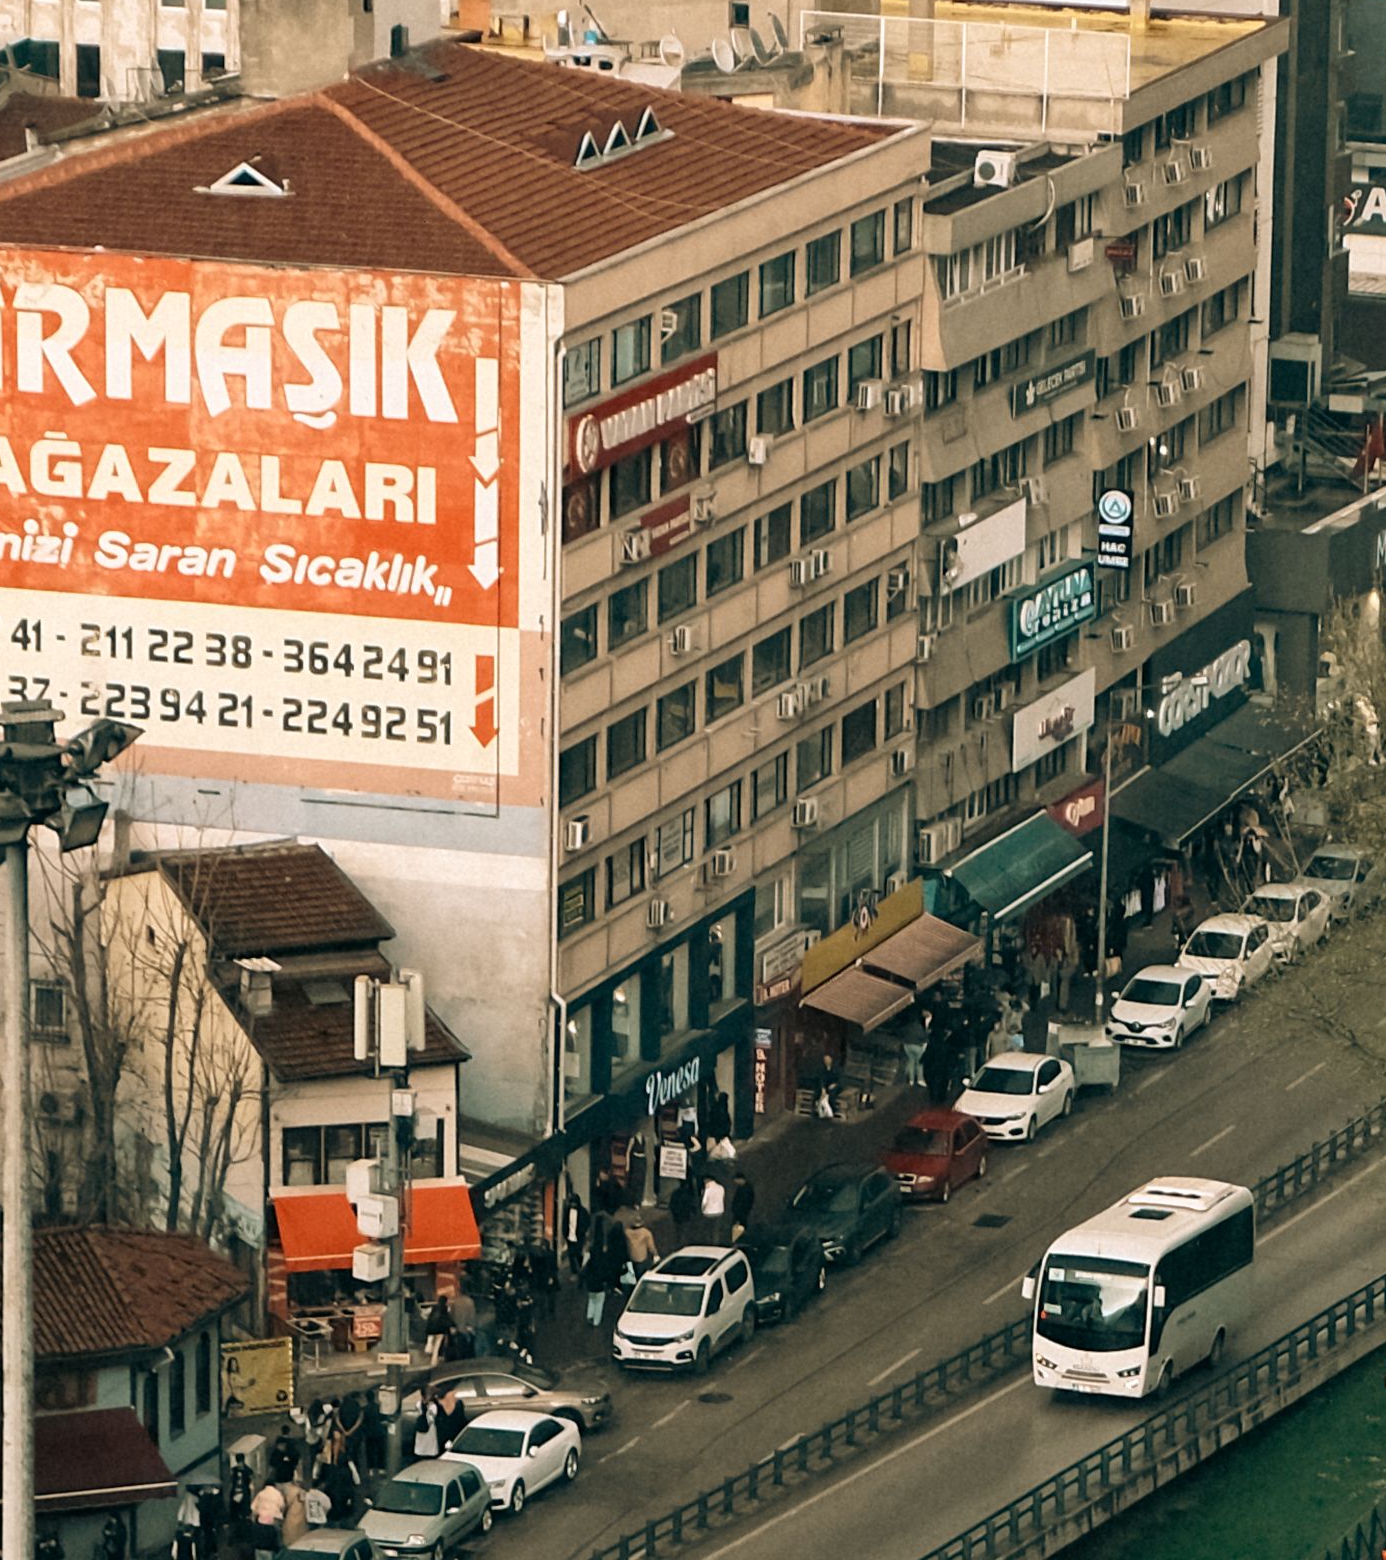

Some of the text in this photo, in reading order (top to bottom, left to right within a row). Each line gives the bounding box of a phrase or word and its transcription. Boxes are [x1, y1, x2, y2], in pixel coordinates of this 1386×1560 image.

[96, 531, 236, 580] Saran
[79, 623, 135, 658] 211
[146, 629, 194, 666] 22
[204, 631, 254, 670] 38
[282, 698, 354, 739] 224
[417, 709, 453, 747] 51
[645, 1055, 700, 1116] Venesa
